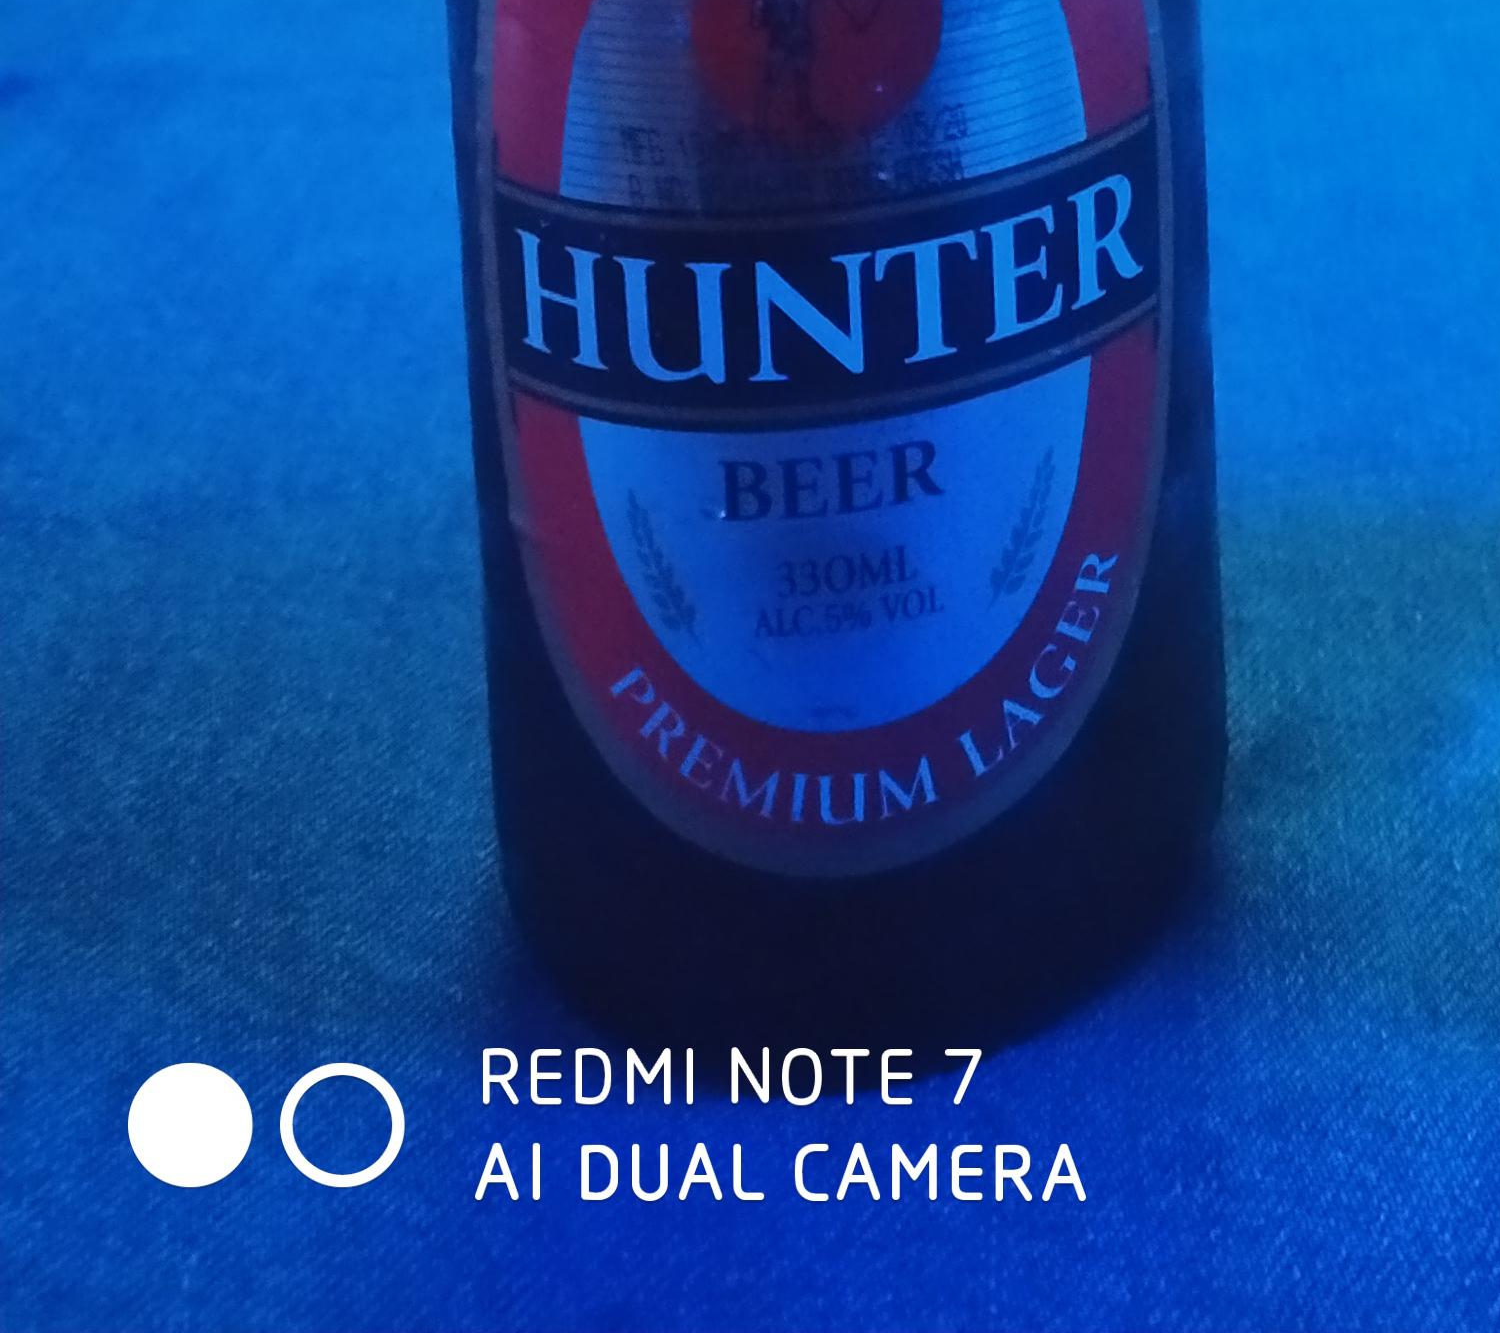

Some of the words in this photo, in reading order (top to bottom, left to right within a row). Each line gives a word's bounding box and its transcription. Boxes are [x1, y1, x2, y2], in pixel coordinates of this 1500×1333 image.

[515, 174, 1144, 384] HUNTER
[718, 440, 946, 522] BEER
[880, 585, 946, 623] VOL
[610, 666, 940, 825] PREMIUM
[957, 550, 1119, 777] LAGER
